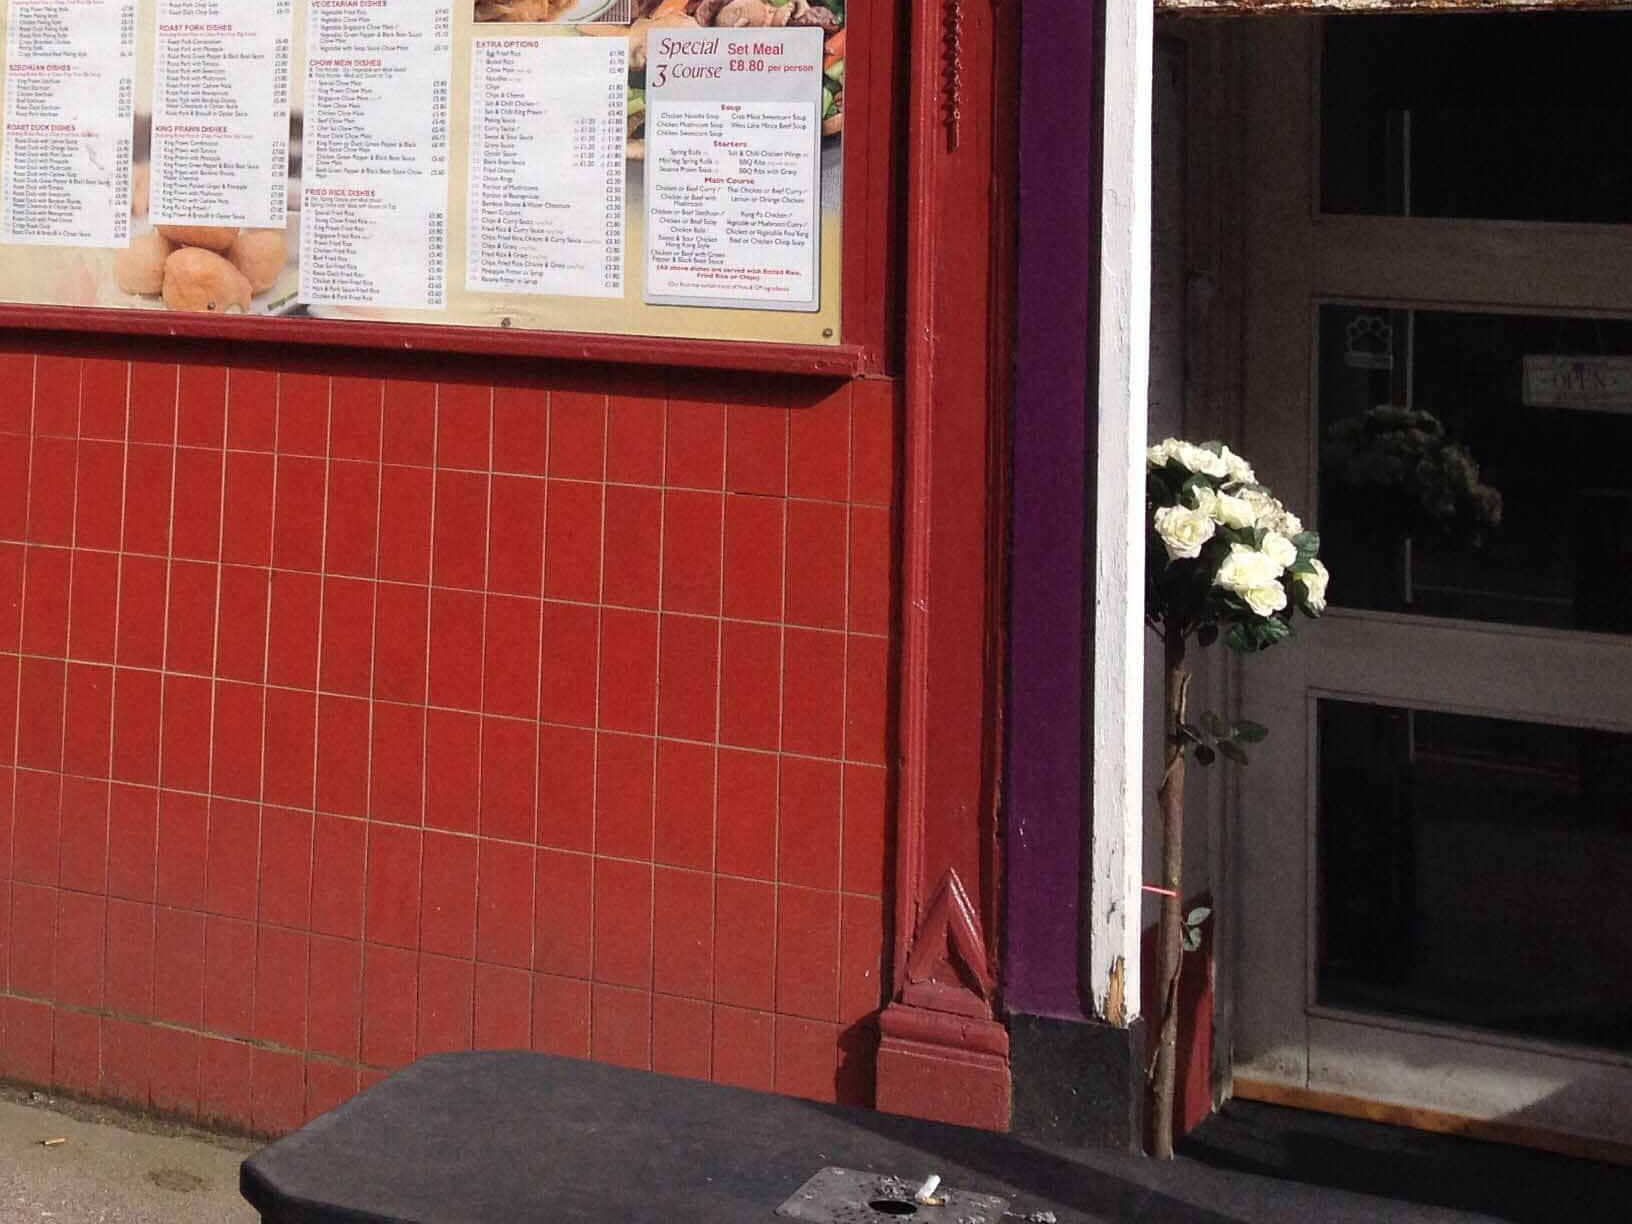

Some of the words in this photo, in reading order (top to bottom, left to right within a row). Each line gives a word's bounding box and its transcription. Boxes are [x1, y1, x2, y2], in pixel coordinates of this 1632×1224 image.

[660, 38, 719, 59] Special
[727, 43, 749, 56] Set
[753, 43, 784, 55] Meal
[729, 60, 764, 72] £8.80
[768, 65, 782, 73] per
[652, 64, 668, 87] 3
[672, 64, 723, 79] Course
[713, 140, 747, 148] Starters
